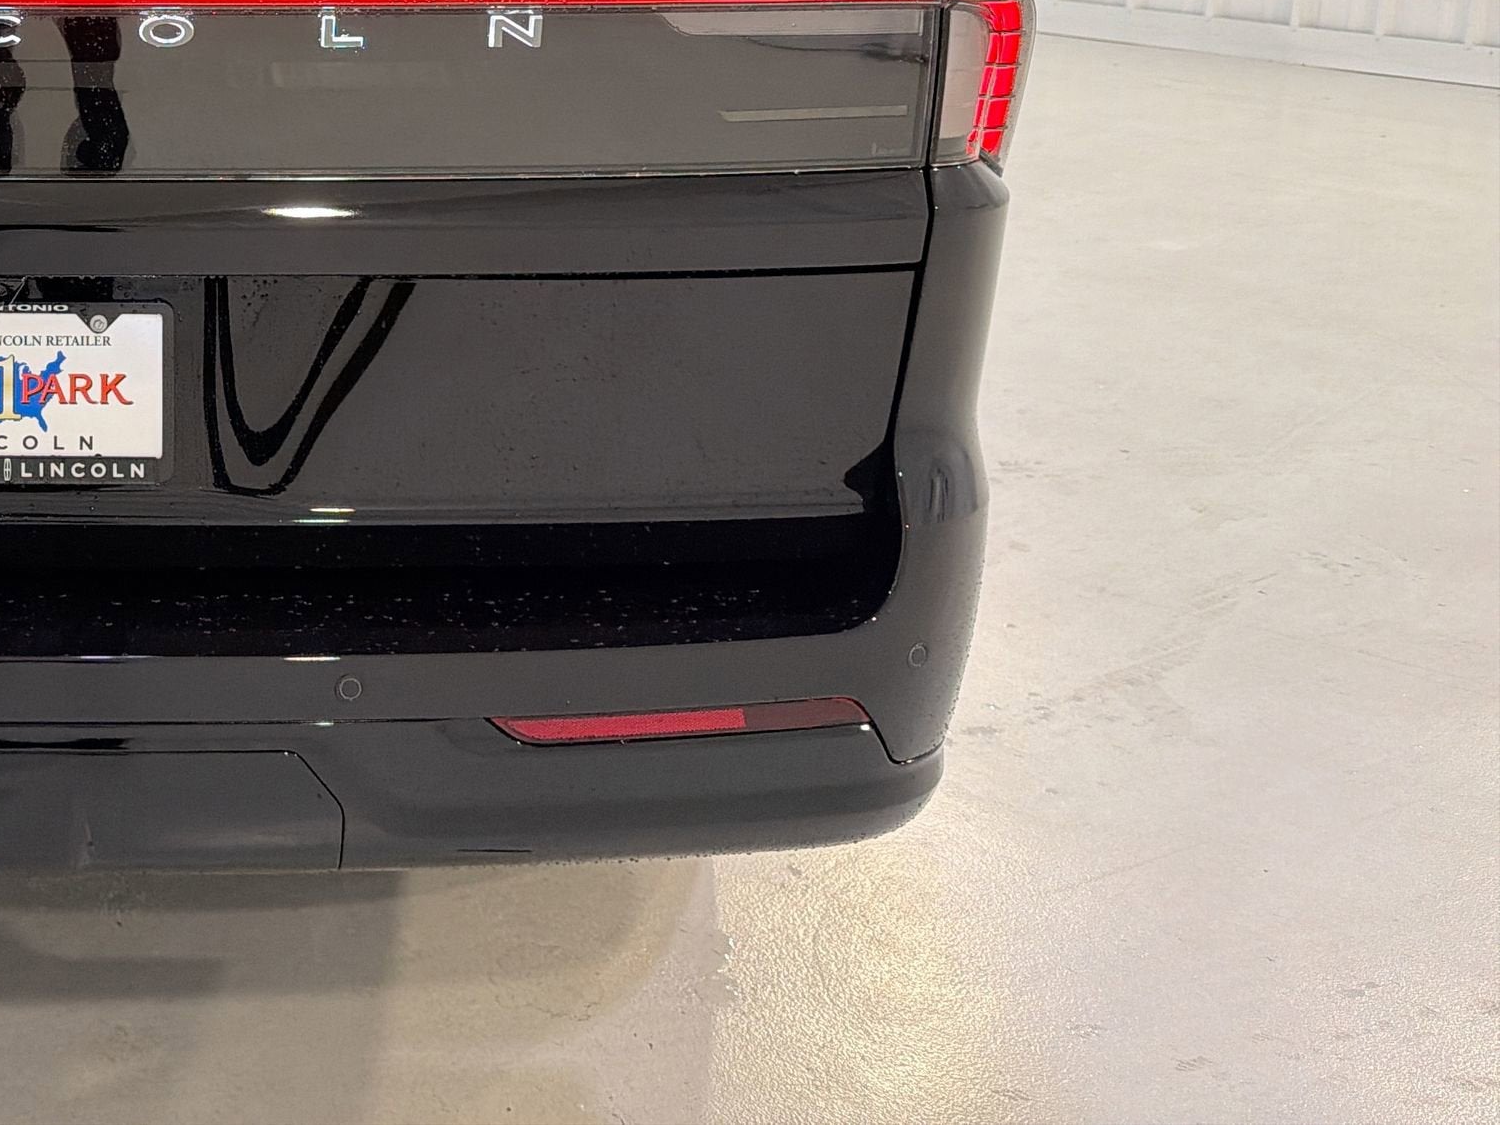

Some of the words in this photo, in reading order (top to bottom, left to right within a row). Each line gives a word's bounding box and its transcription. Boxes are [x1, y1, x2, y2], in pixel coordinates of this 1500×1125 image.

[46, 335, 112, 347] RETAILER
[20, 373, 134, 405] PARK
[20, 462, 145, 479] LINCOLN
